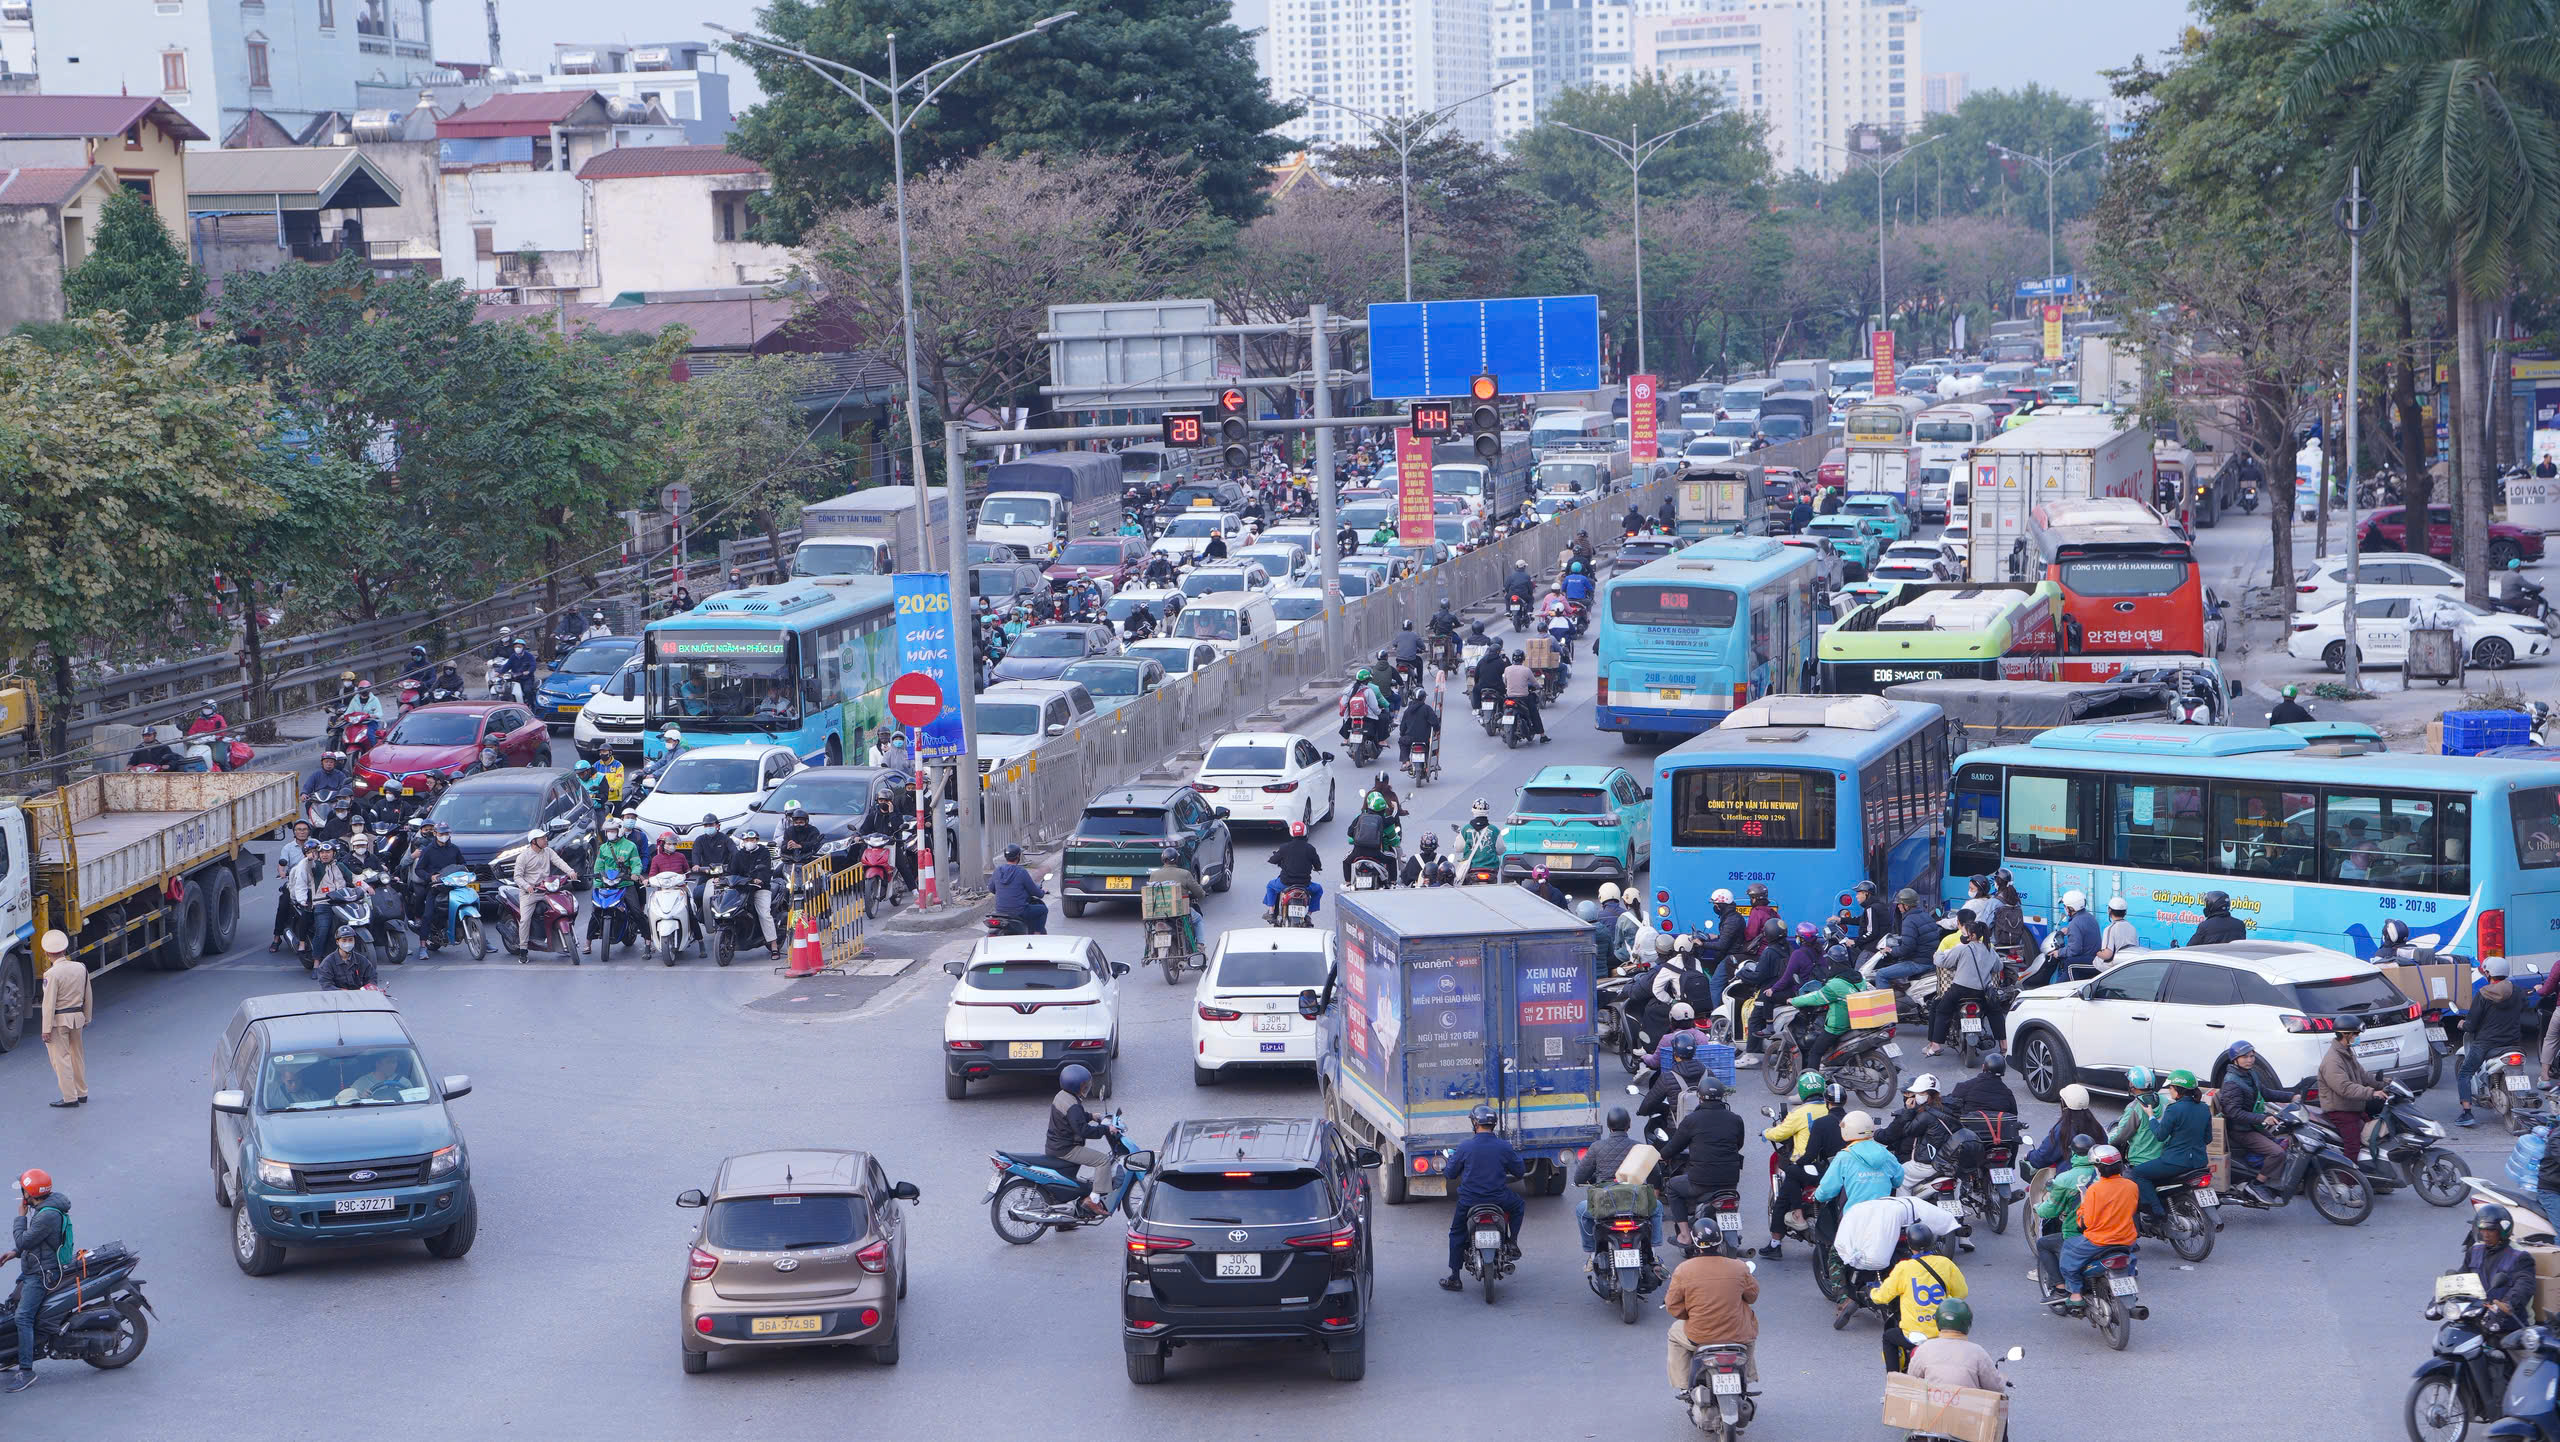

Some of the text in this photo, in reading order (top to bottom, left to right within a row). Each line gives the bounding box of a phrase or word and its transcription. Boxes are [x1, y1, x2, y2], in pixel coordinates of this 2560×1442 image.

[1418, 410, 1446, 429] 144
[1173, 420, 1198, 440] 28
[2072, 562, 2090, 571] CÔNG
[2102, 564, 2116, 572] VẬN
[898, 594, 950, 615] 2026
[1661, 592, 1688, 608] 60B
[906, 626, 945, 642] CHÚC
[907, 646, 949, 662] MỪNG
[2091, 663, 2110, 674] 99F
[1874, 669, 1944, 682] E06 SMART CITY
[1971, 772, 1994, 781] SAMCO
[1708, 800, 1726, 809] CÔNG
[1726, 801, 1735, 809] TY
[1736, 801, 1744, 809] CP
[1745, 800, 1758, 811] VẬN
[1770, 802, 1799, 810] NEWWAY
[1742, 820, 1763, 836] 48
[1729, 872, 1776, 881] 29E-208.07
[2152, 890, 2170, 902] Giải
[2172, 892, 2195, 908] pháp
[2380, 896, 2396, 910] 29B
[2406, 899, 2436, 914] 207.98
[1526, 967, 1578, 980] XEM NGAY
[1534, 979, 1572, 996] NỆM RẺ
[1445, 995, 1461, 1004] GIAO
[1463, 993, 1480, 1003] HÀNG
[1536, 1002, 1583, 1023] 2 TRIỆU
[1463, 1031, 1479, 1039] ĐÊM
[1262, 1043, 1273, 1052] TẬP
[338, 1198, 392, 1212] 29C-372.71
[724, 1245, 850, 1257] DISCOVERY
[1229, 1255, 1248, 1264] 30K
[1222, 1266, 1256, 1275] 262.20
[1912, 1277, 1946, 1306] be
[759, 1320, 815, 1330] 36A-374.96
[1715, 1384, 1740, 1394] 270.30
